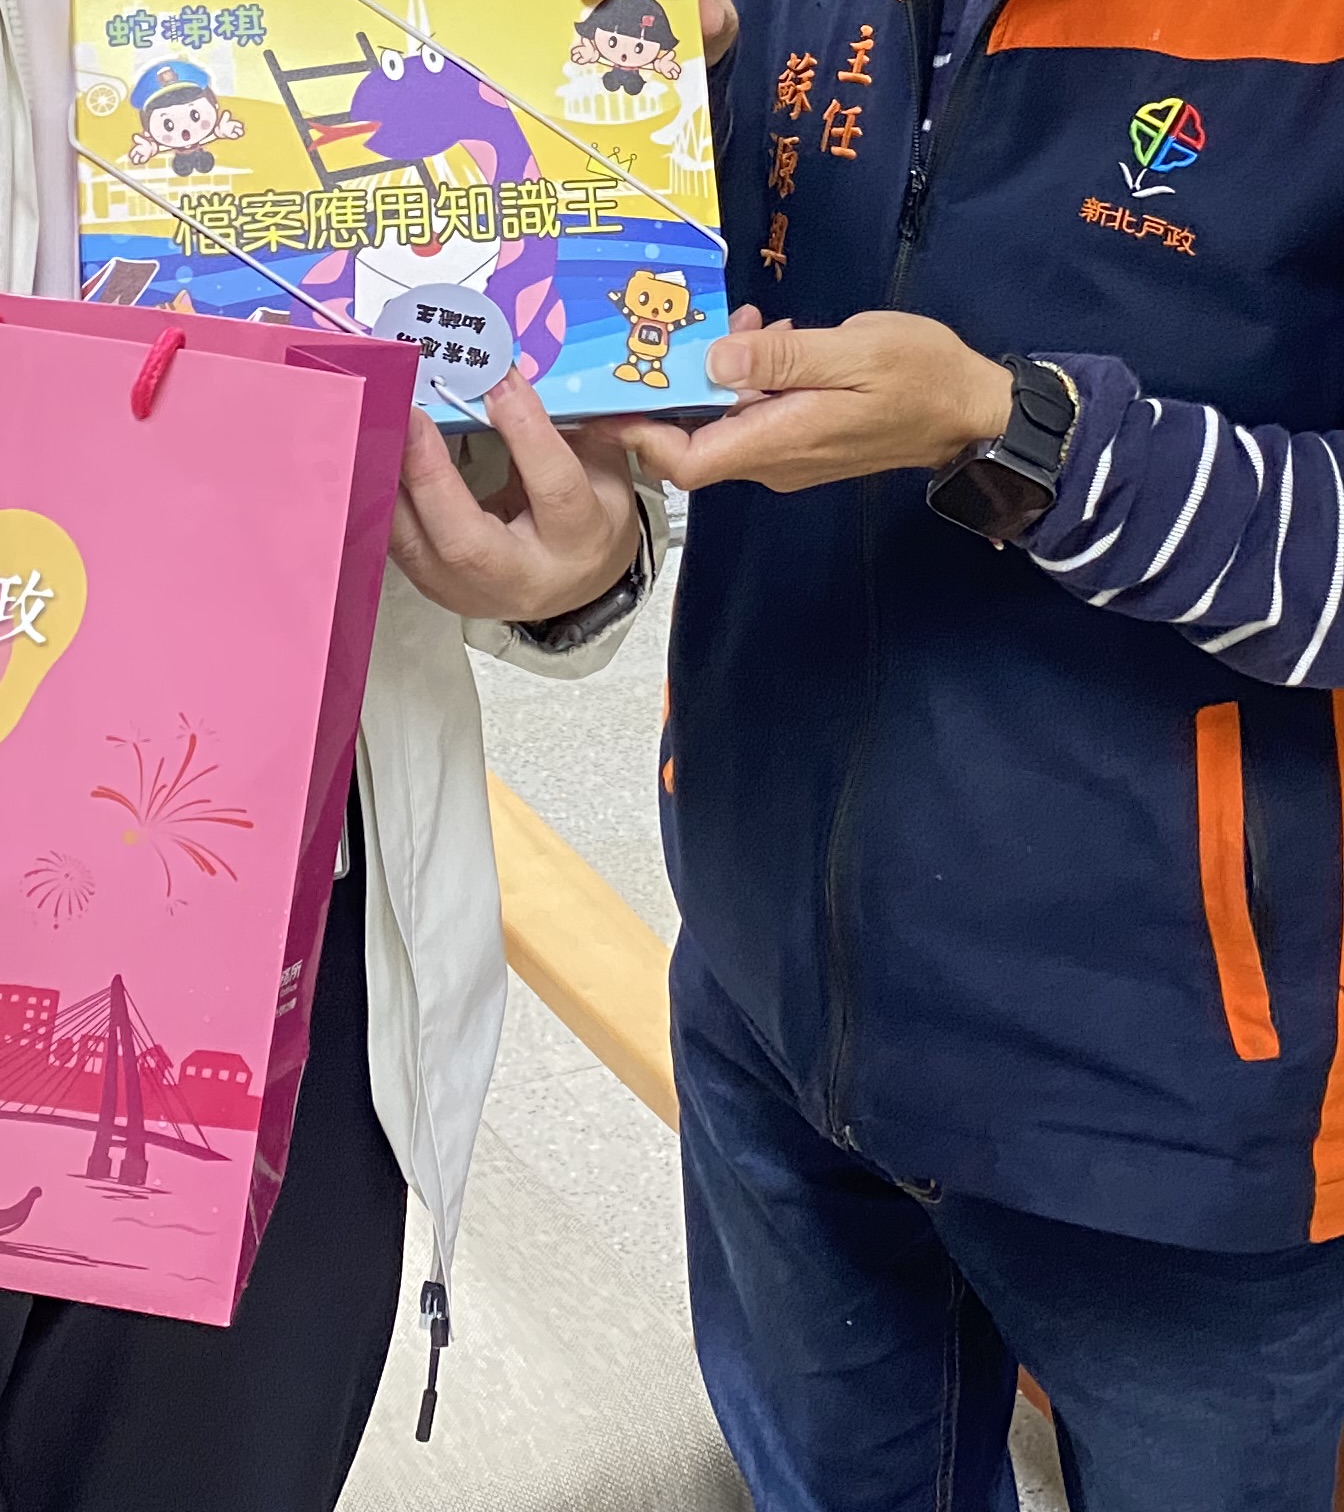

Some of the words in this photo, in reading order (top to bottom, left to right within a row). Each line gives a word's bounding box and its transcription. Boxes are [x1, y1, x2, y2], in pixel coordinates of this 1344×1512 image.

[106, 3, 267, 51] 蛇梯棋
[820, 24, 875, 160] 主任
[174, 177, 626, 258] 檔案應用知識王
[1078, 195, 1198, 257] 新北戶政
[415, 303, 487, 335] 知識王
